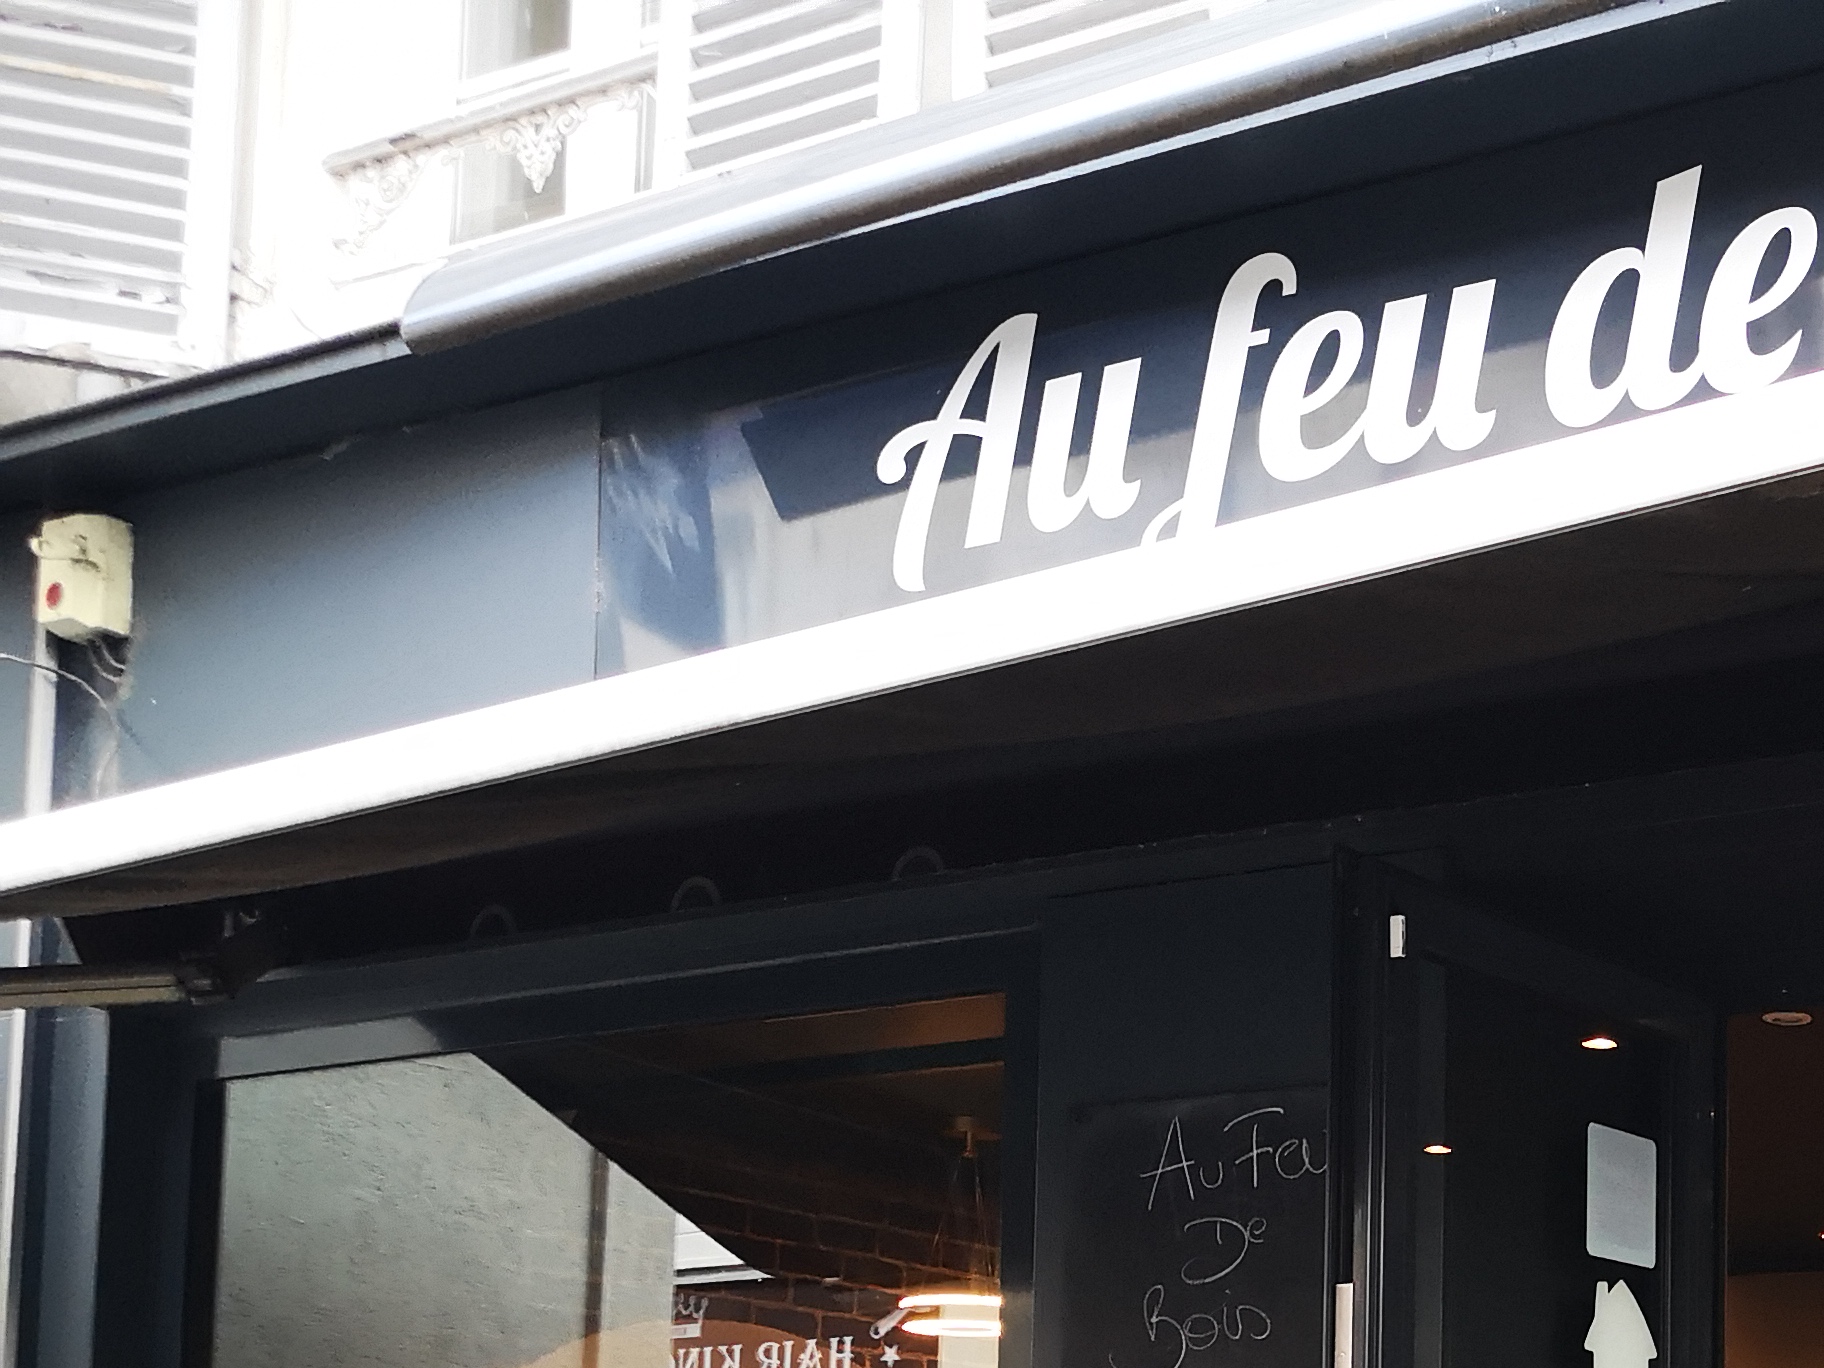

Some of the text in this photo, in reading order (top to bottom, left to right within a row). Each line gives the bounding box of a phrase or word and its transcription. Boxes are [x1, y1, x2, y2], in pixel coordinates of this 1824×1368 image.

[876, 312, 1142, 592] Au
[1141, 252, 1498, 548] feu
[1544, 164, 1818, 430] de
[1181, 1216, 1268, 1285] De
